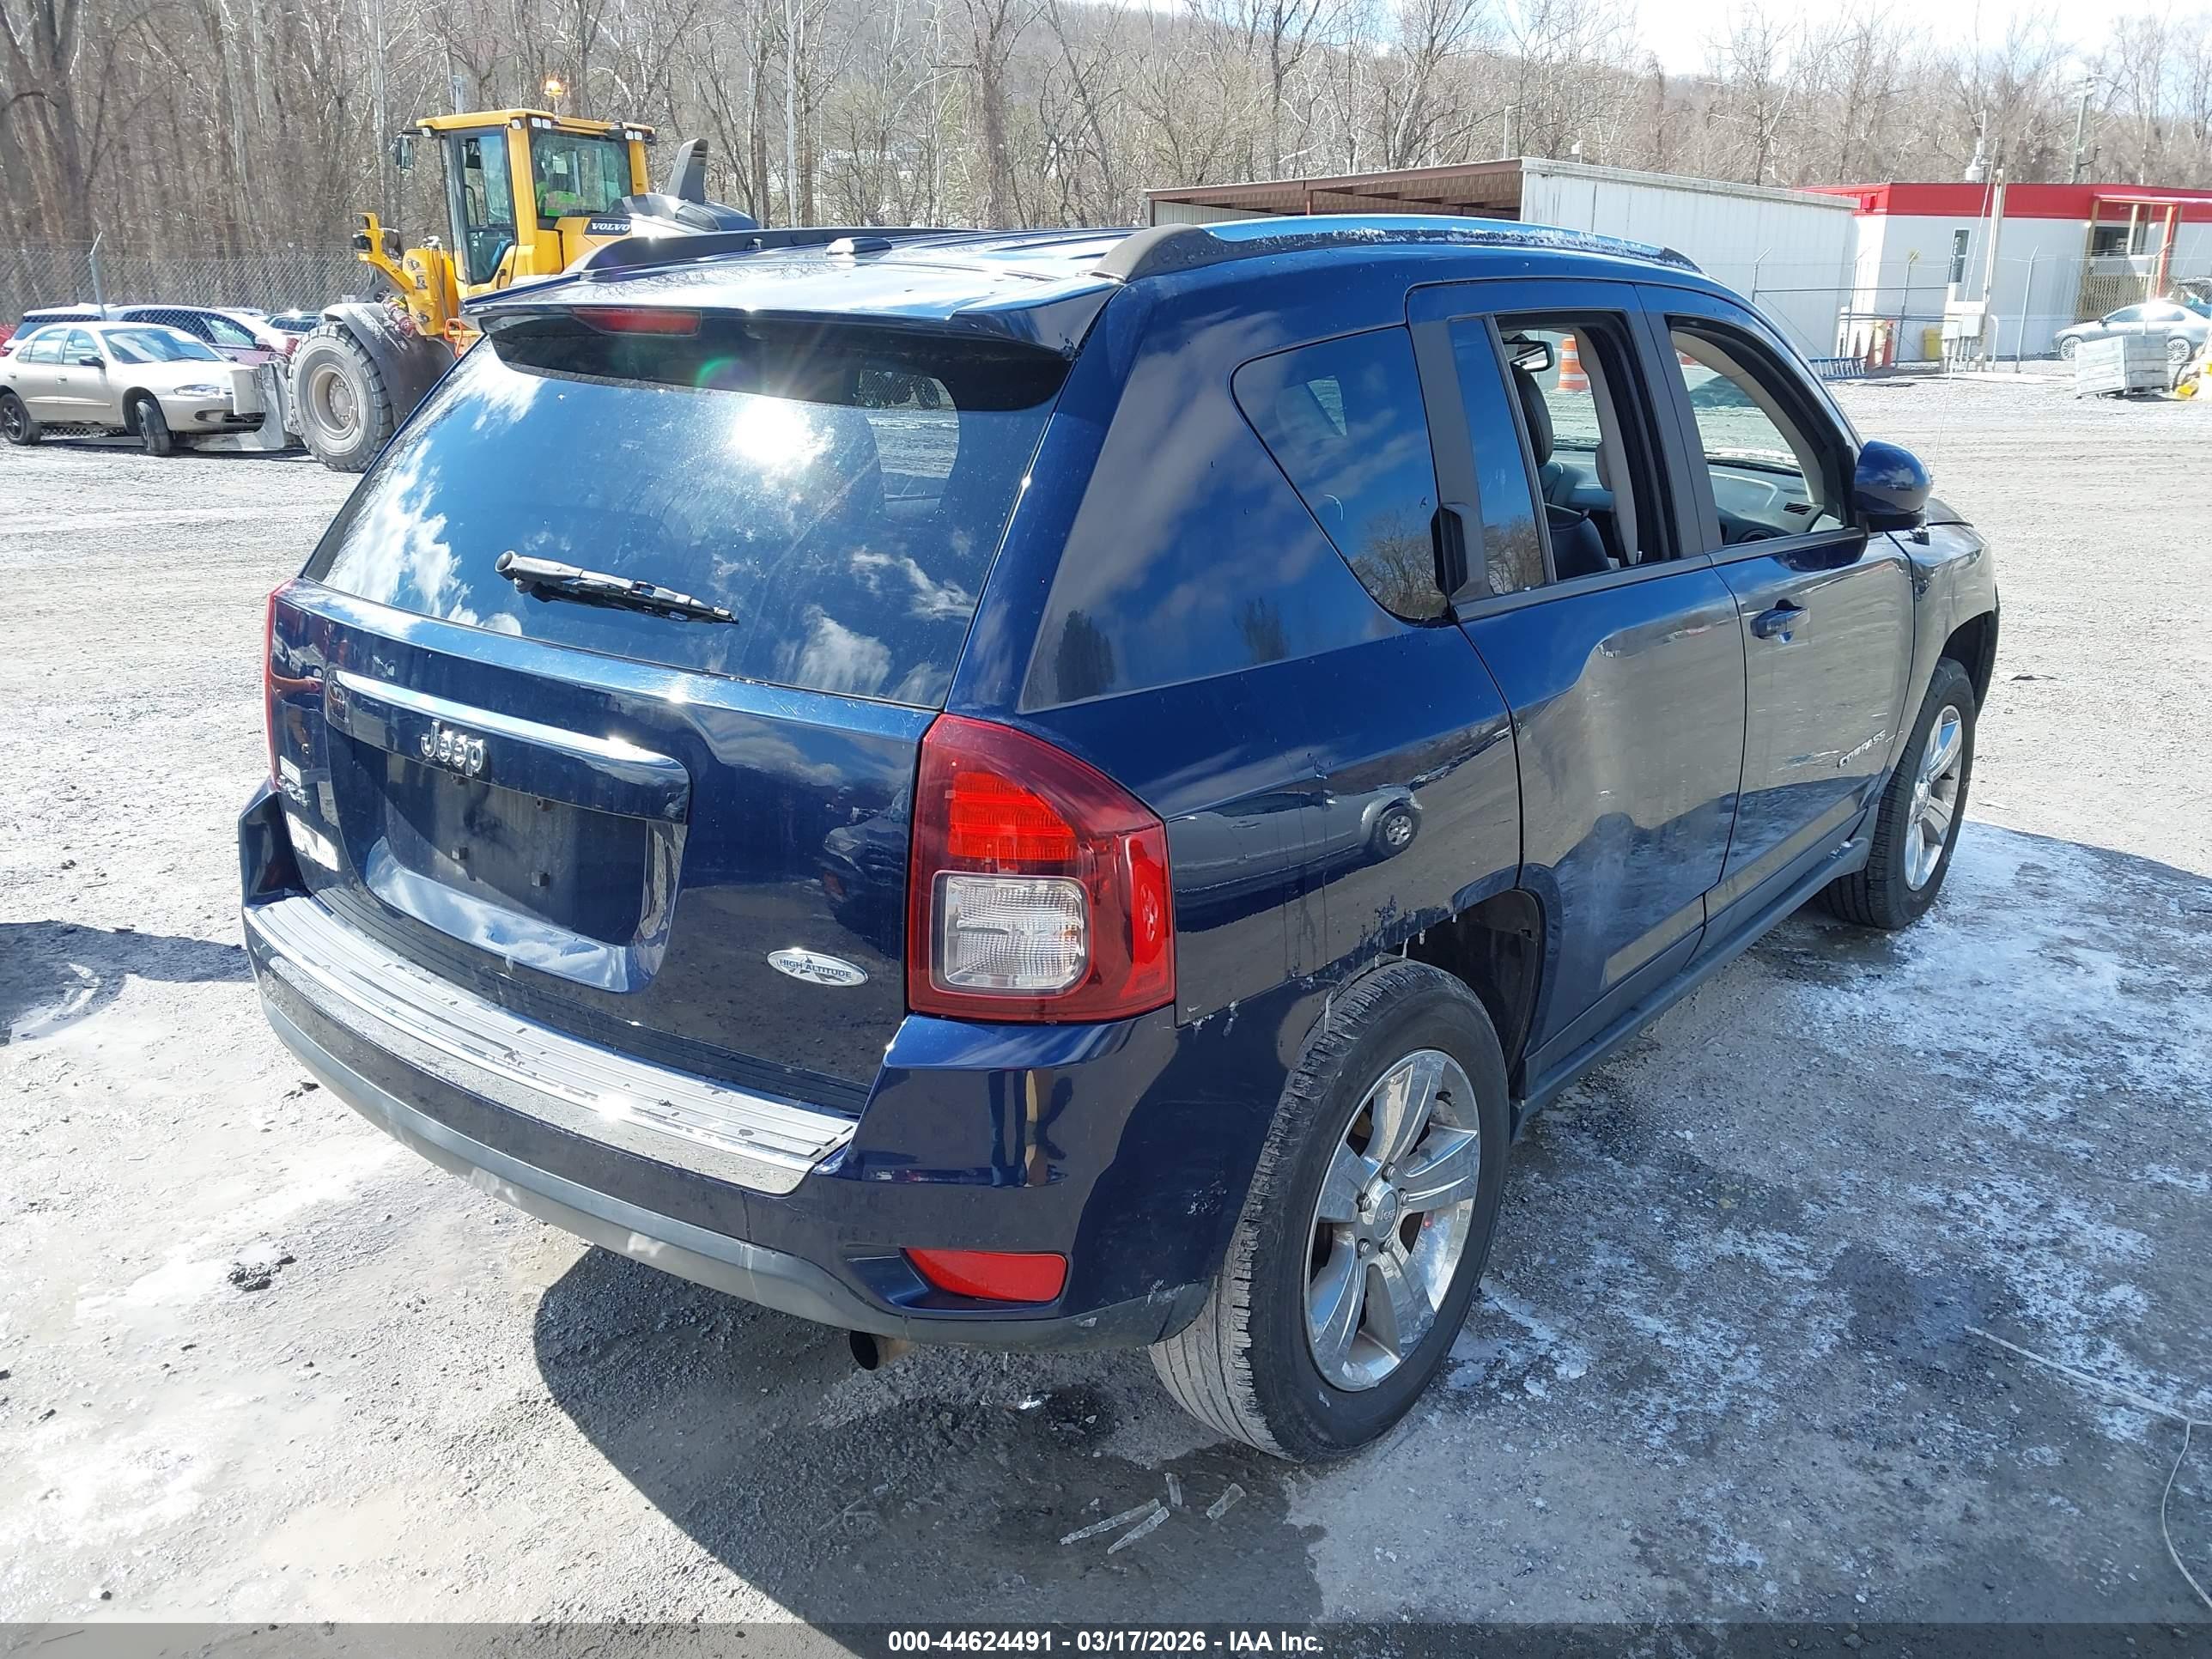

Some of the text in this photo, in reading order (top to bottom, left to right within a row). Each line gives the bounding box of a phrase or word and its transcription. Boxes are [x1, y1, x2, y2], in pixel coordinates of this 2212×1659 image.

[592, 222, 631, 231] VOLVO
[421, 719, 483, 776] Jeep
[779, 959, 852, 978] HIGH ALTITUDE
